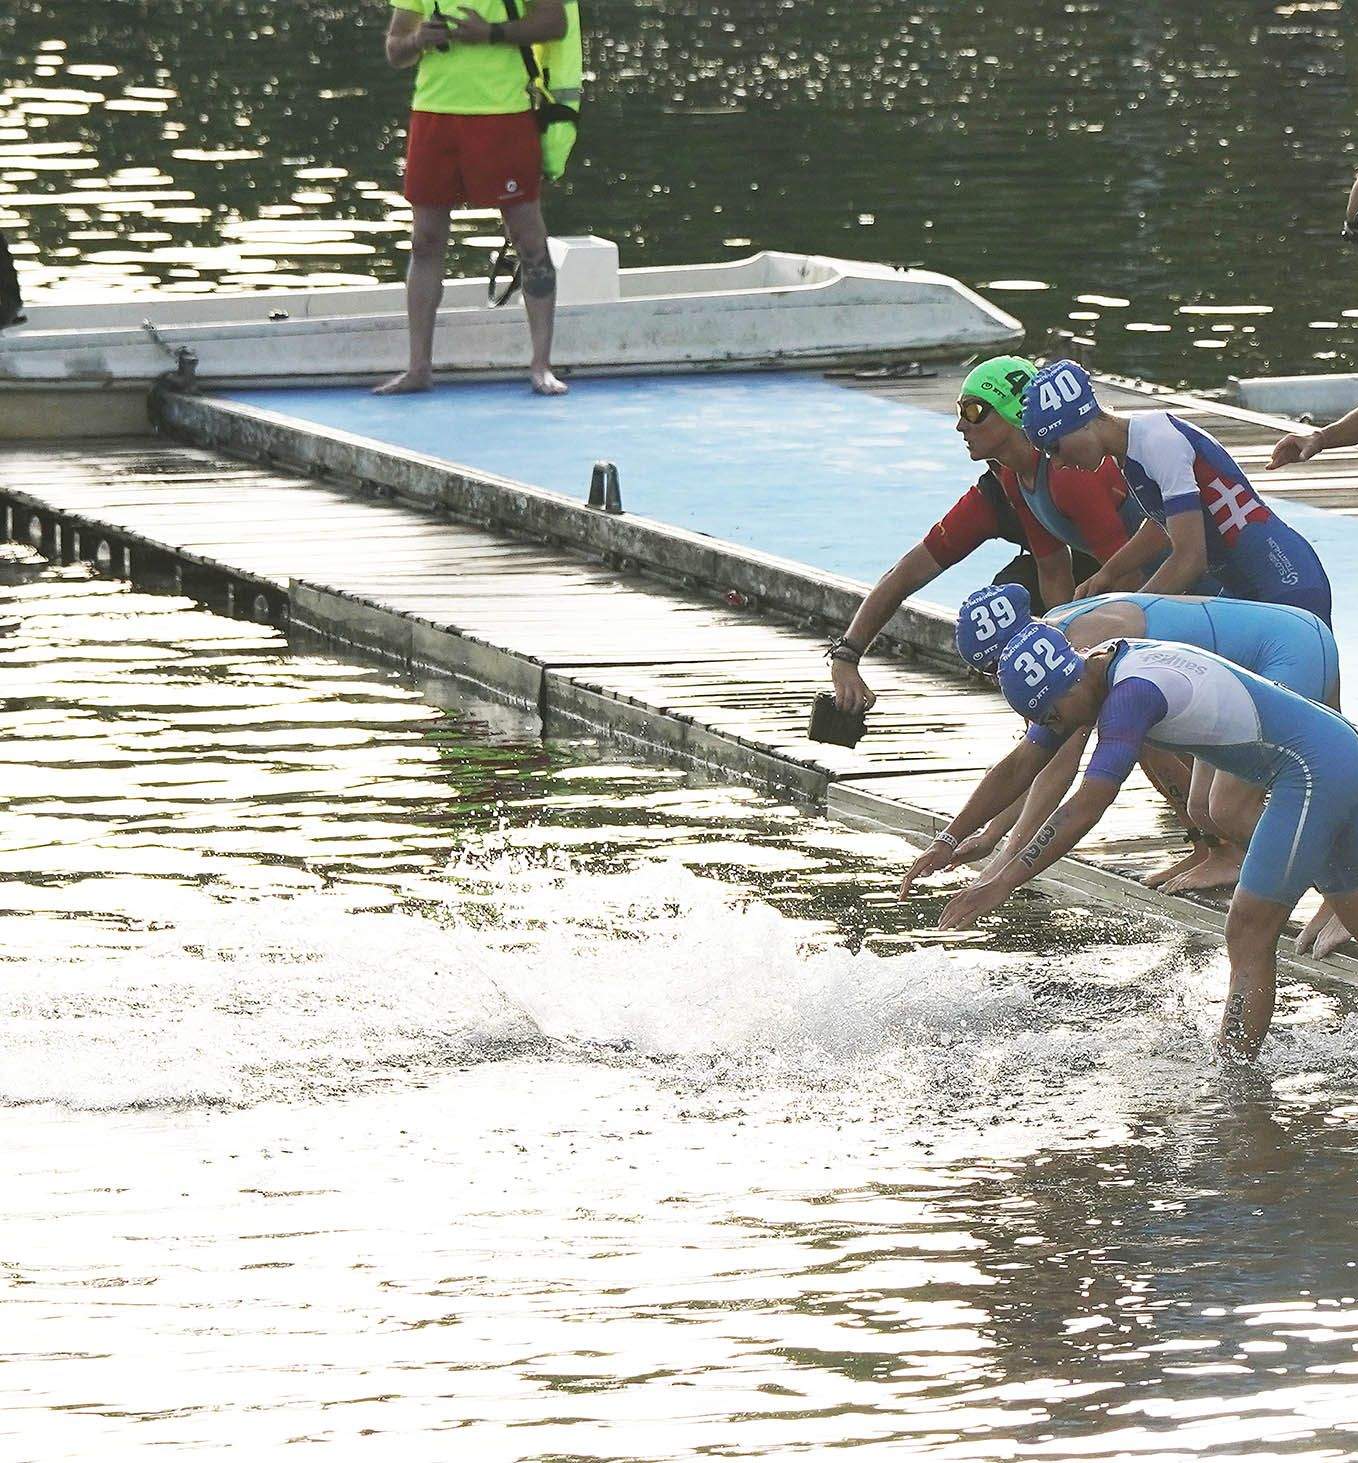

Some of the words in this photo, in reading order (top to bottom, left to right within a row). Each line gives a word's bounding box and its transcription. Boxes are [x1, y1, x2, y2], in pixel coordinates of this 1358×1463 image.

[1040, 369, 1082, 411] 40
[1048, 419, 1062, 431] NTT
[970, 595, 1017, 641] 39
[984, 643, 999, 655] NTT
[1013, 637, 1066, 687] 32
[1036, 685, 1050, 699] NTT
[1021, 824, 1056, 868] 32
